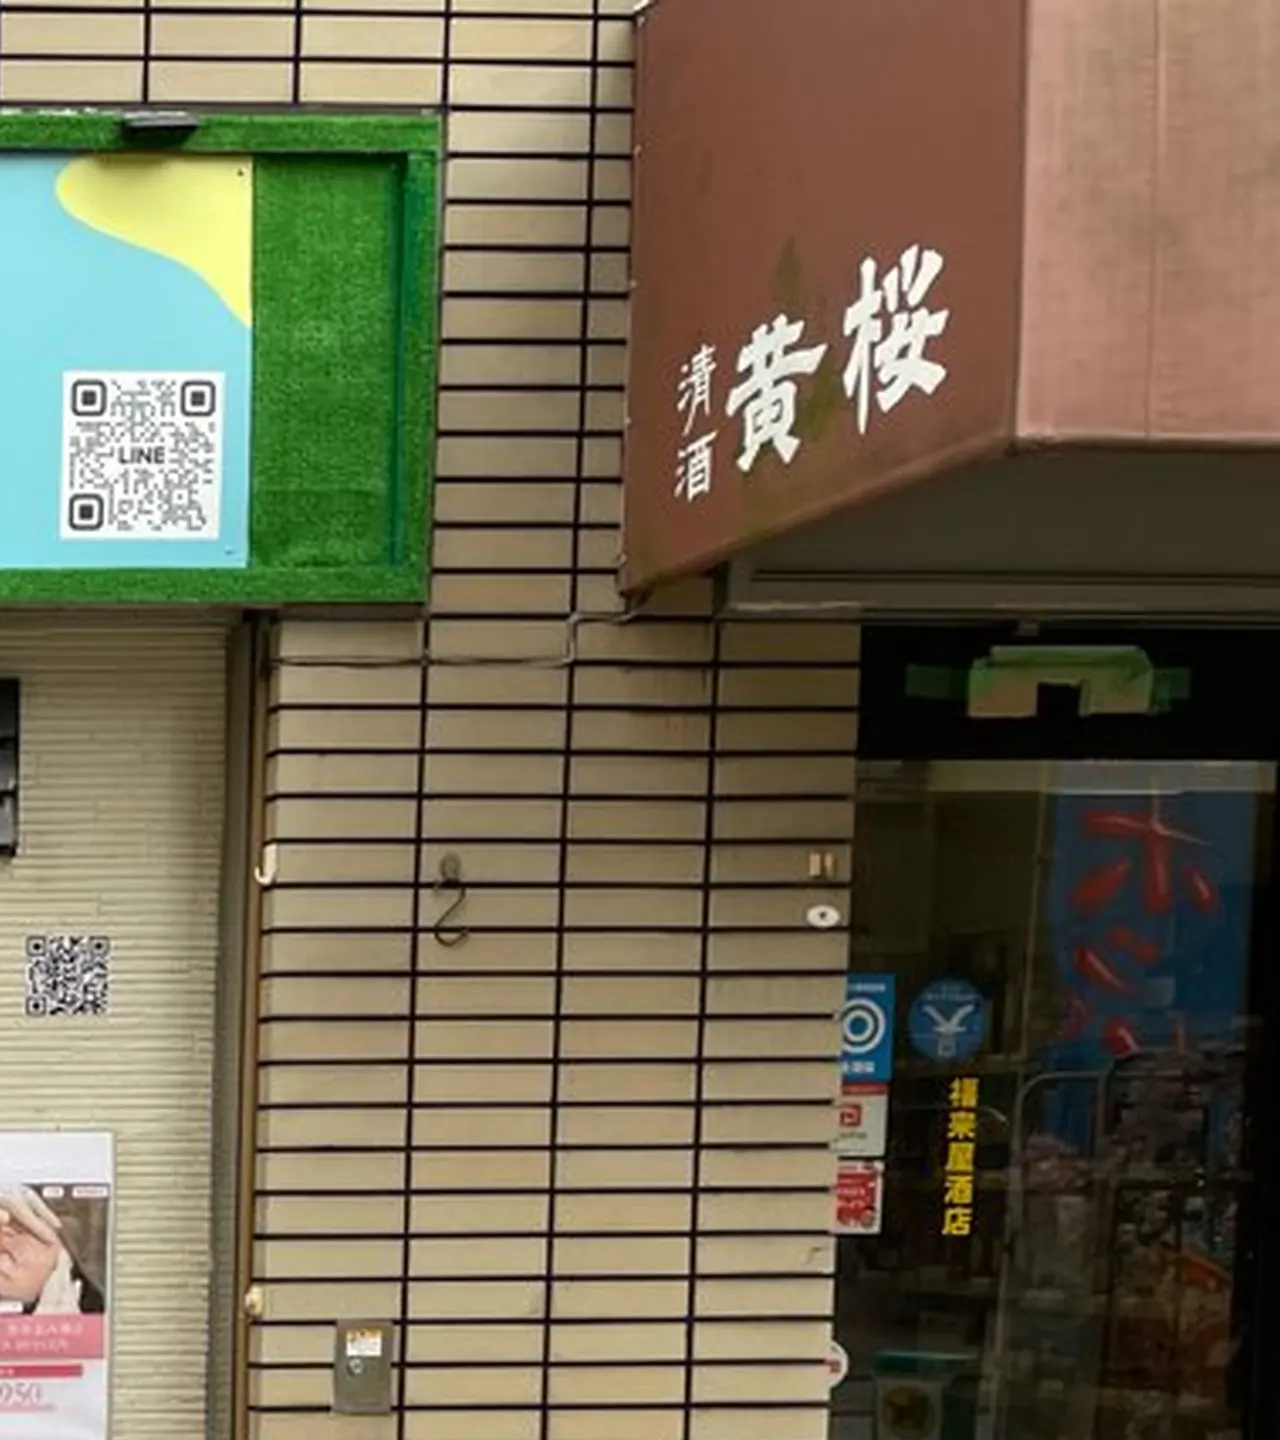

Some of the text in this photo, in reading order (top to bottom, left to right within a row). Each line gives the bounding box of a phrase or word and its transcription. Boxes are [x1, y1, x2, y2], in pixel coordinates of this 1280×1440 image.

[674, 344, 718, 501] 清酒
[725, 244, 950, 473] 黄桜
[118, 446, 165, 465] LINE
